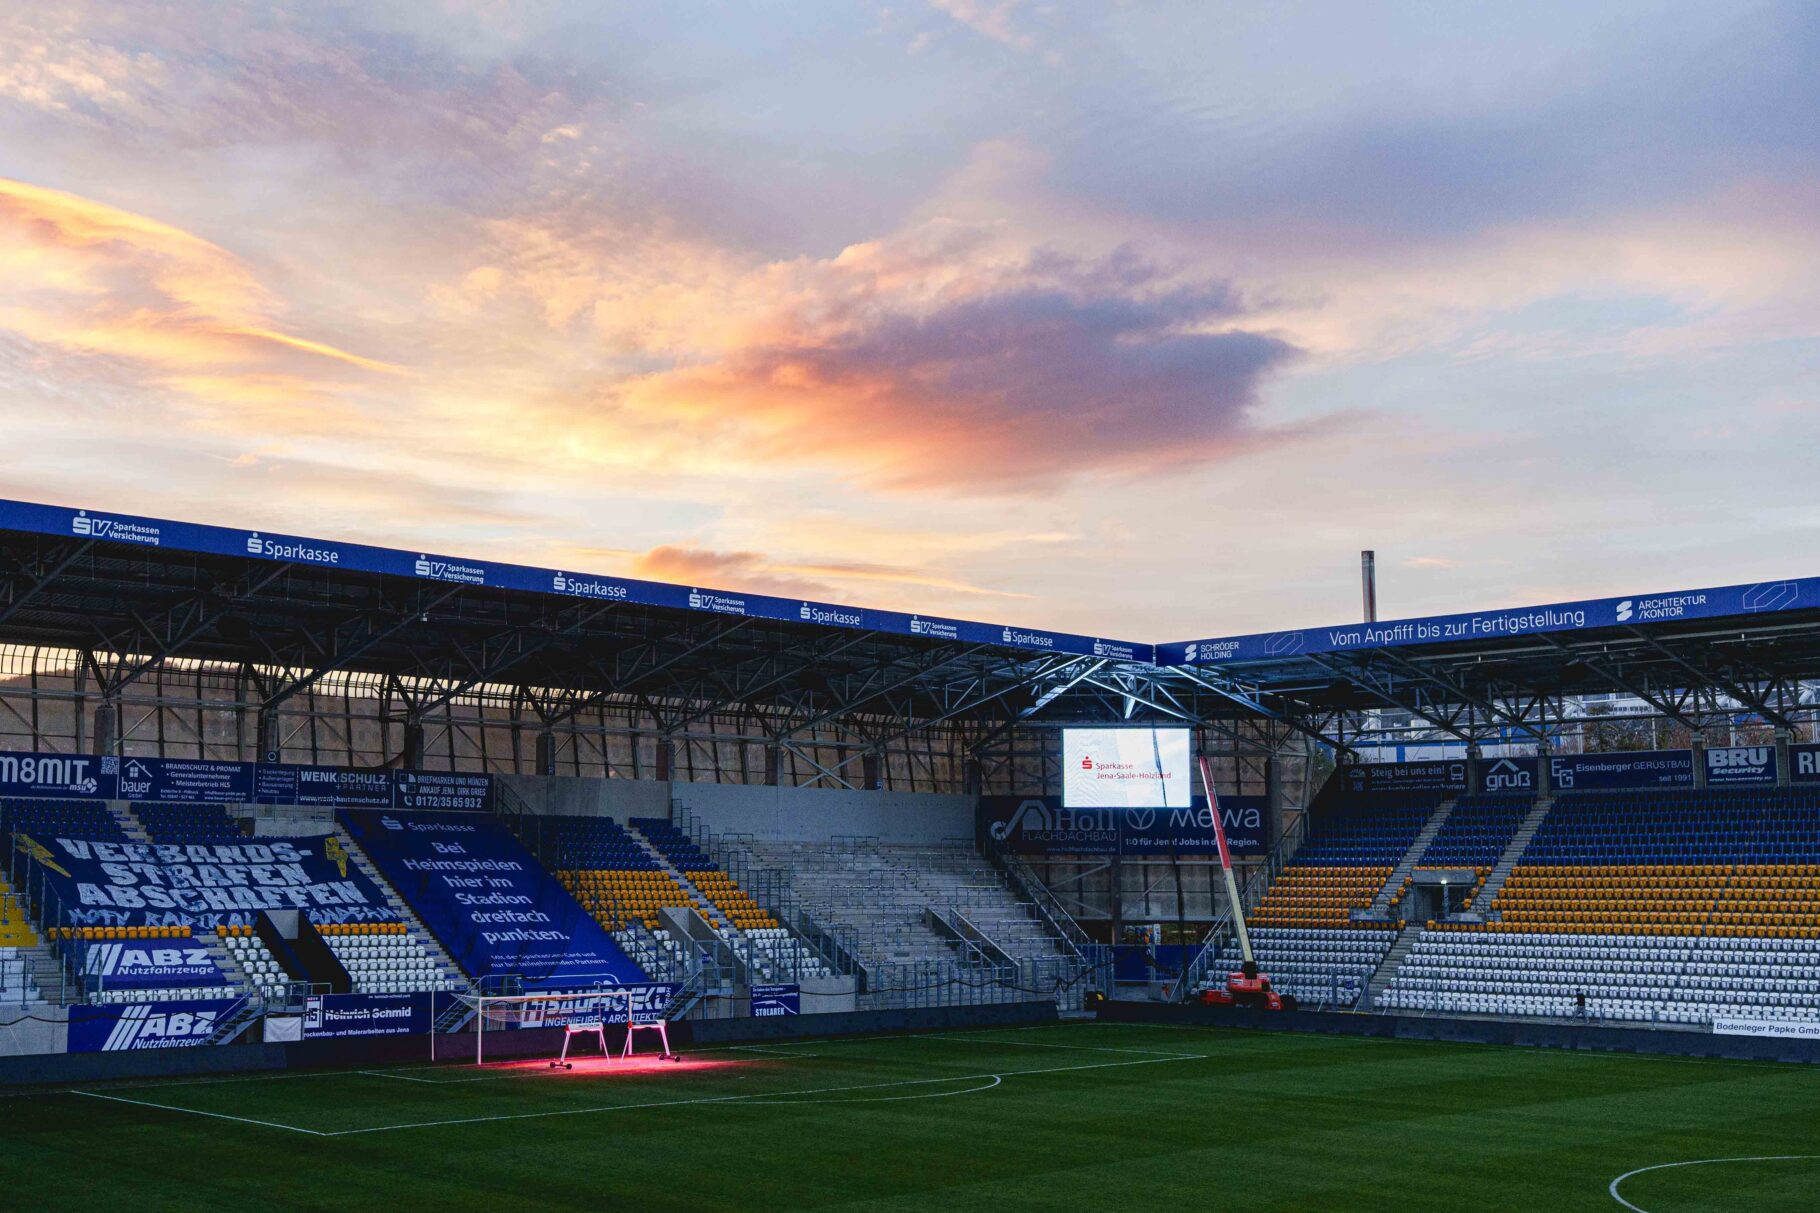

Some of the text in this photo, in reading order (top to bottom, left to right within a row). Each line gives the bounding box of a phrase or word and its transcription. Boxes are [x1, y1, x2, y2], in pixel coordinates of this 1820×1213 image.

[114, 522, 159, 534] Sparkassen
[108, 530, 159, 545] Versicherung
[264, 540, 338, 562] Sparkasse
[448, 564, 484, 575] Sparkassen
[444, 572, 484, 584] Versicherung
[568, 578, 626, 597] Sparkasse
[715, 596, 744, 606] Sparkassen
[1638, 595, 1706, 610] ARCHITEKTUR
[712, 604, 744, 614] Versicherung
[812, 608, 860, 625] Sparkasse
[1329, 610, 1585, 647] Vom Anpfiff bis zur Fertigstellung
[1012, 632, 1053, 646] Sparkasse
[1201, 642, 1239, 652] SCHRÖDER
[1201, 650, 1232, 660] HOLDING
[1708, 748, 1767, 767] BRU
[1371, 768, 1393, 779] Steig
[1395, 767, 1408, 776] bei
[1428, 764, 1445, 774] ein!
[1576, 760, 1690, 772] Eisenberger GERÜSTBAU
[301, 771, 390, 784] WENK SCHULZ.
[418, 776, 454, 784] BRIEFMARKEN
[468, 776, 488, 786] MÜNZEN
[122, 777, 151, 792] bauer
[471, 788, 486, 796] GRIES
[1054, 808, 1116, 831] Holl
[408, 822, 476, 832] Sparkasse
[1022, 831, 1117, 841] FLACHDACHBAU
[1227, 838, 1260, 847] Region.
[56, 838, 312, 863] VERBANDS-
[431, 842, 467, 853] Bei
[402, 858, 523, 872] Heimspielen
[101, 862, 312, 888] STRAFEN
[442, 875, 514, 888] hier im
[77, 881, 368, 912] ABSCHAFFEN
[455, 892, 533, 905] Stadion
[471, 910, 550, 923] dreifach
[482, 928, 570, 945] punkten.
[120, 949, 212, 966] ABZ
[117, 966, 215, 976] Nutzfahrzeuge
[546, 987, 666, 1014] BAUPROEKT
[325, 1007, 411, 1020] Heinrich Schmid
[755, 1008, 784, 1016] STOLAREK
[138, 1012, 217, 1037] ABZ
[545, 1016, 600, 1027] INGENIEURE
[1716, 1023, 1766, 1033] Bodenleger
[1769, 1024, 1795, 1034] Papke
[131, 1037, 205, 1050] Nutzfahrzeu
